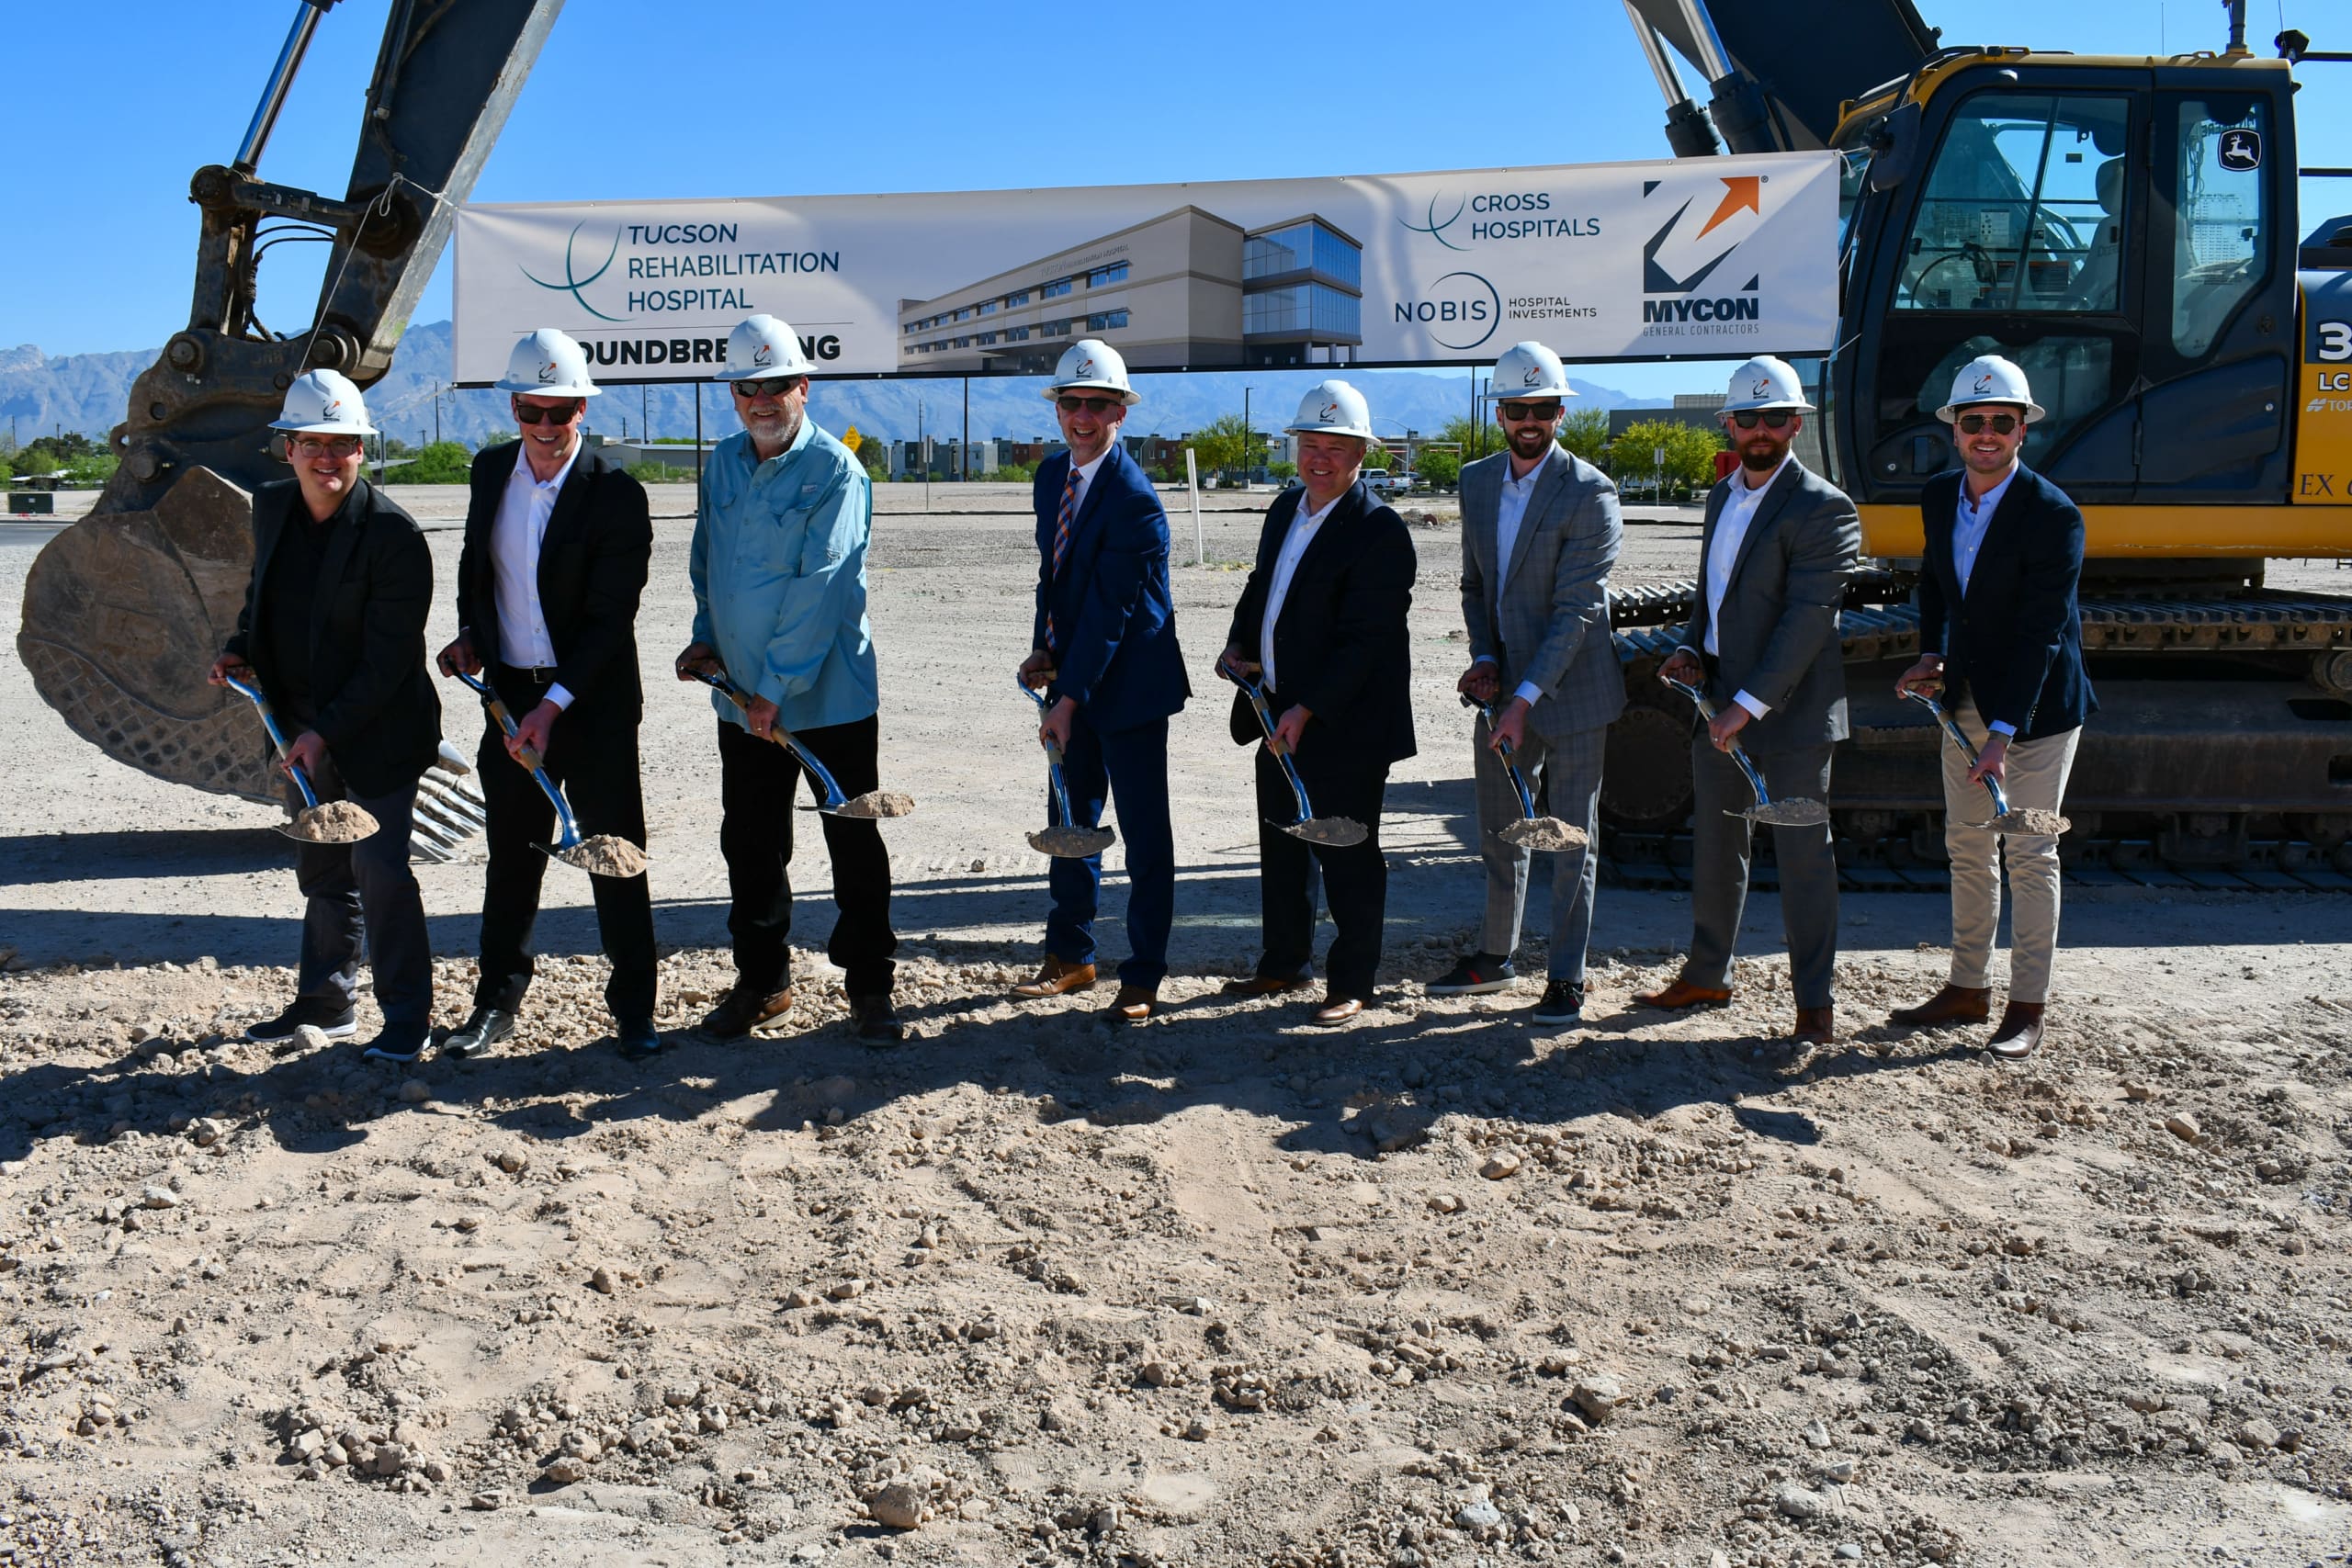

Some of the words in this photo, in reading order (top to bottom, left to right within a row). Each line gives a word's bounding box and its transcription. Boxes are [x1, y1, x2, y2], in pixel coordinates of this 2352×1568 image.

[1472, 193, 1550, 213] CROSS
[628, 223, 738, 244] TUCSON
[1472, 218, 1600, 240] HOSPITALS
[628, 251, 840, 278] REHABILITATION
[628, 288, 754, 312] HOSPITAL
[1509, 297, 1570, 308] HOSPITAL
[1643, 298, 1759, 323] MYCON
[1395, 300, 1487, 322] NOBIS
[1509, 308, 1598, 319] INVESTMENTS
[1643, 324, 1687, 337] GENERAL
[1690, 323, 1760, 336] CONTRACTORS
[2318, 373, 2349, 391] LC
